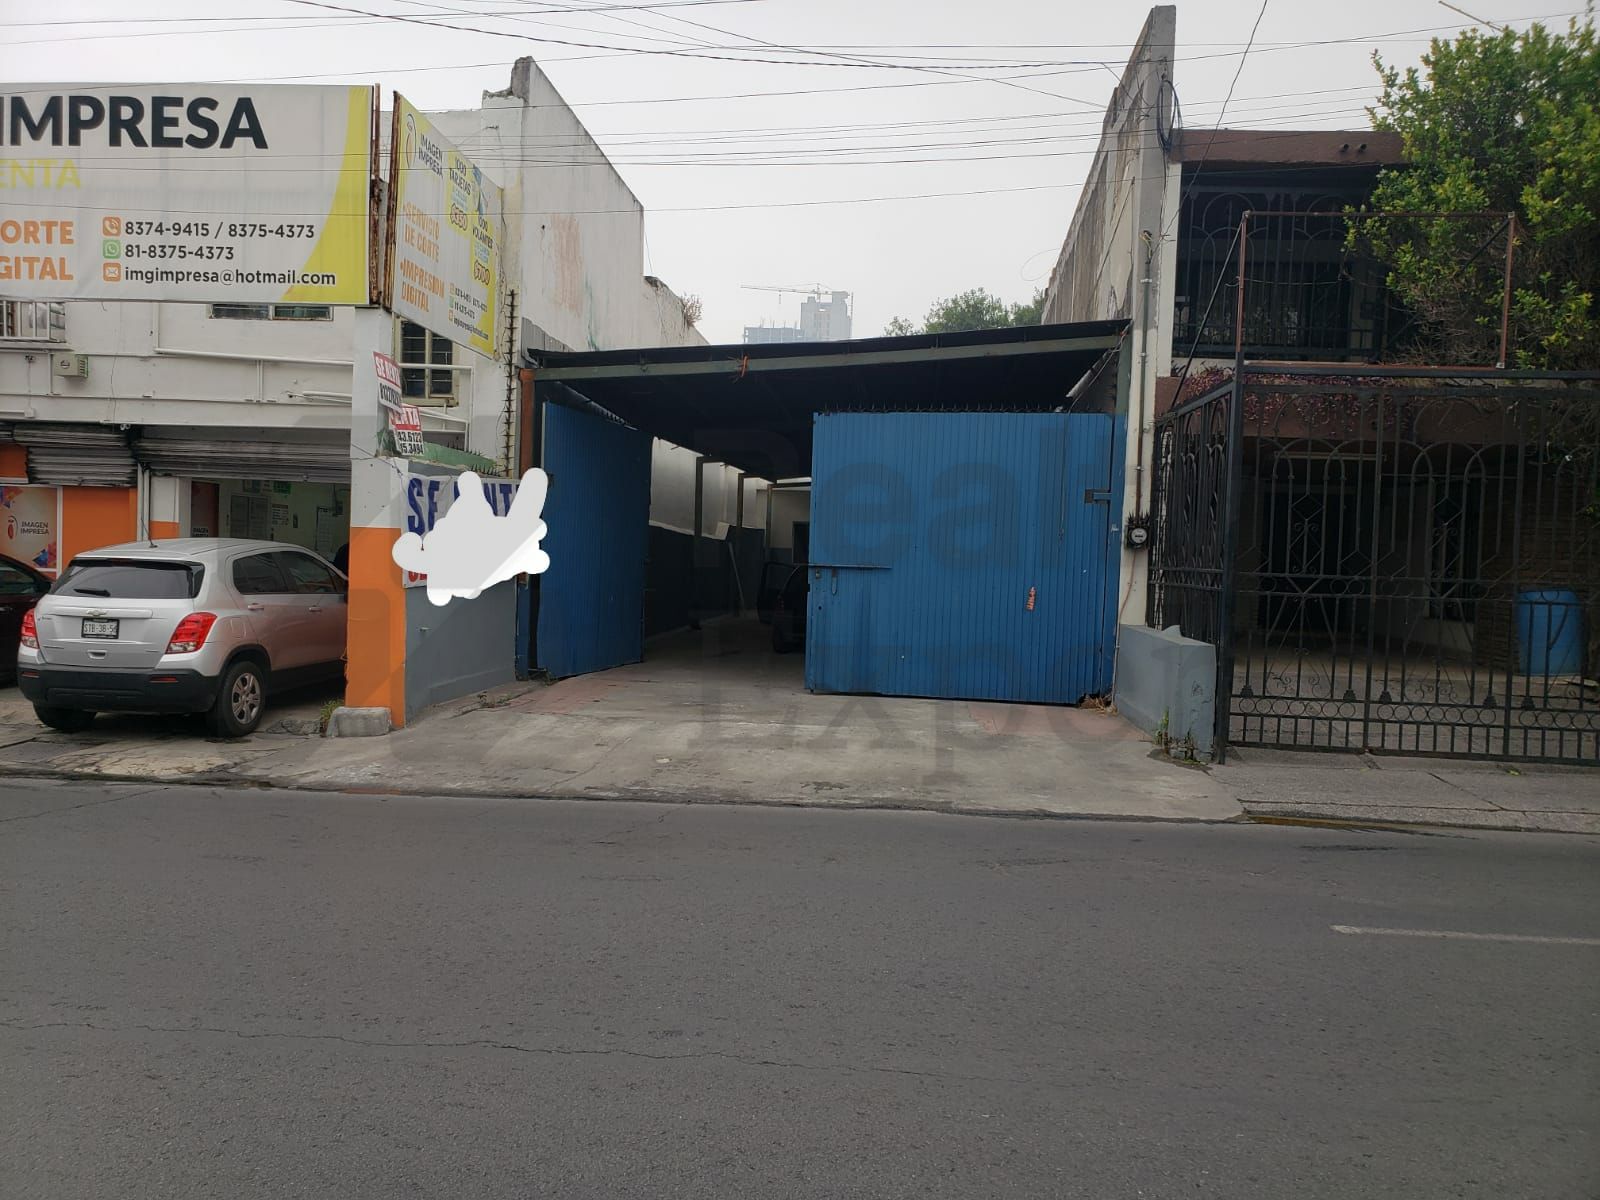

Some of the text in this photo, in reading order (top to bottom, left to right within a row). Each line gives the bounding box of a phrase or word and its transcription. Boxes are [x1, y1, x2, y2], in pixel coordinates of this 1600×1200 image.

[0, 96, 268, 149] IMPRESA
[421, 133, 442, 163] IMAGEN
[0, 220, 74, 245] ORTE
[125, 221, 210, 237] 8374-9415
[228, 223, 315, 239] 8375-4373
[125, 244, 234, 260] 81-8375-4373
[125, 267, 336, 286] imgimpresa@hotmail.com
